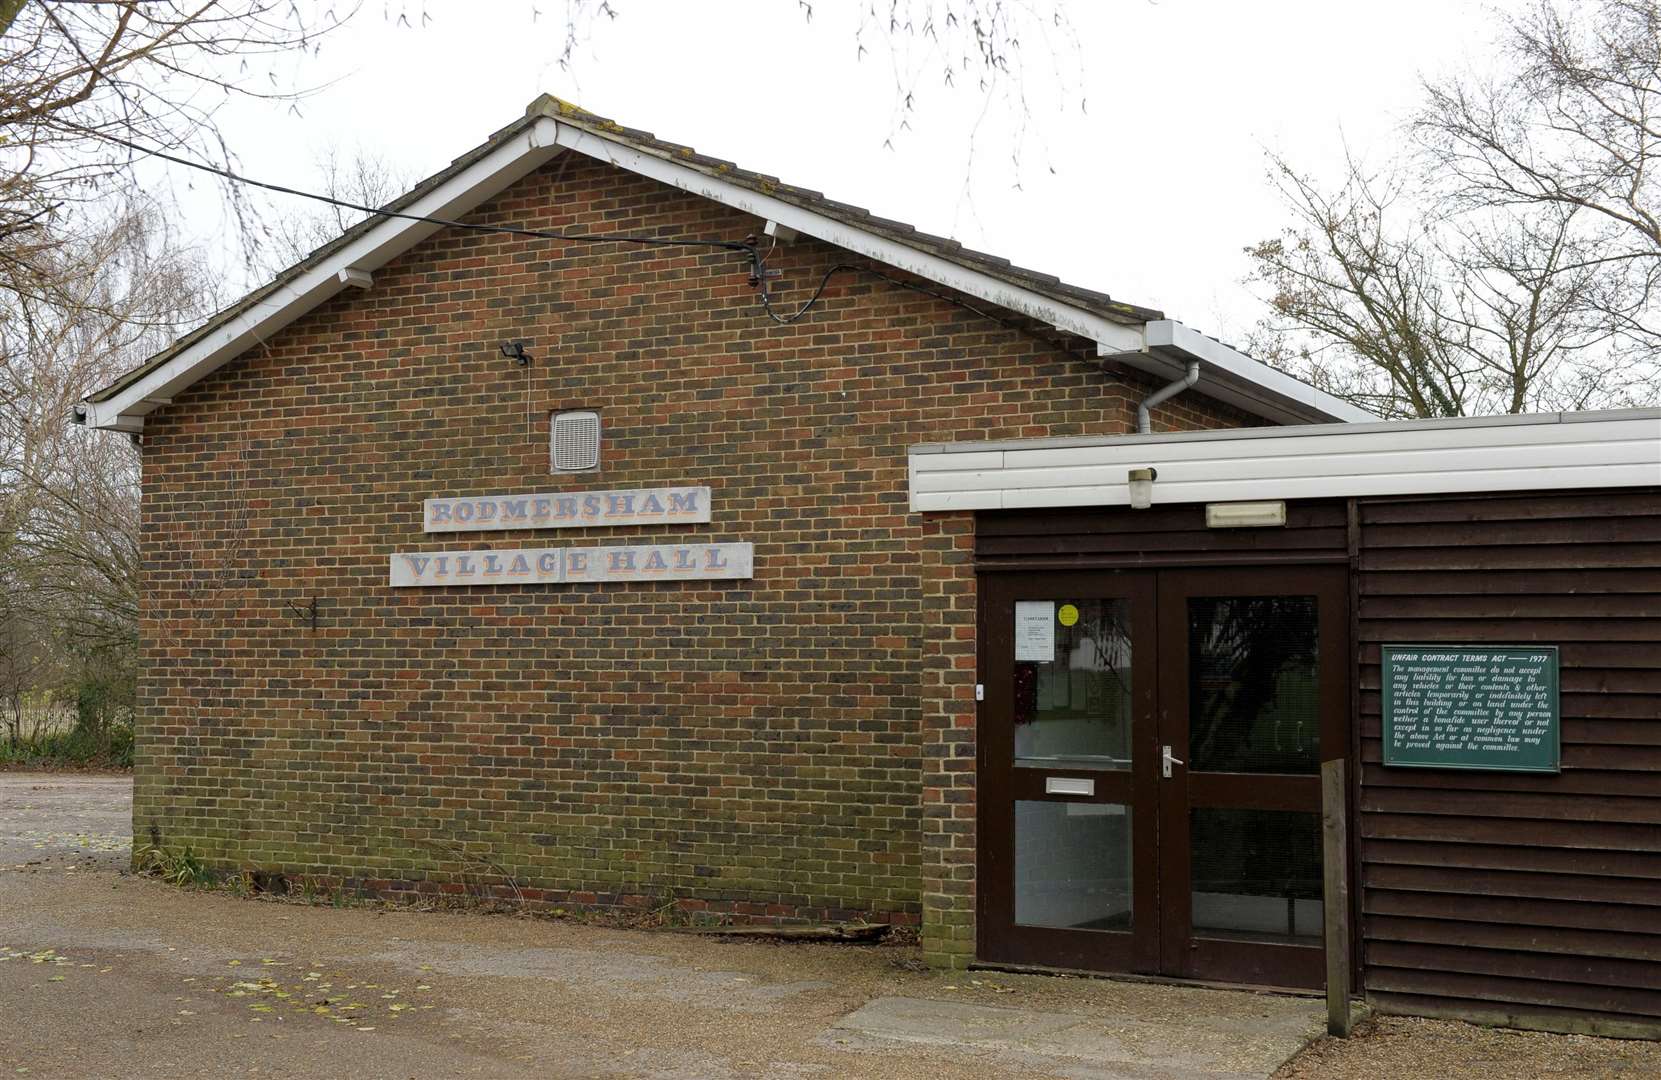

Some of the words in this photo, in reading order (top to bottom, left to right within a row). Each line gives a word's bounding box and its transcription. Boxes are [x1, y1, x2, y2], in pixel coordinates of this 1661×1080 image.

[431, 491, 699, 525] RODMERSHAM
[407, 552, 589, 577] VILLAGE
[607, 549, 728, 572] HALL
[1458, 682, 1474, 690] their
[1492, 676, 1522, 684] damage
